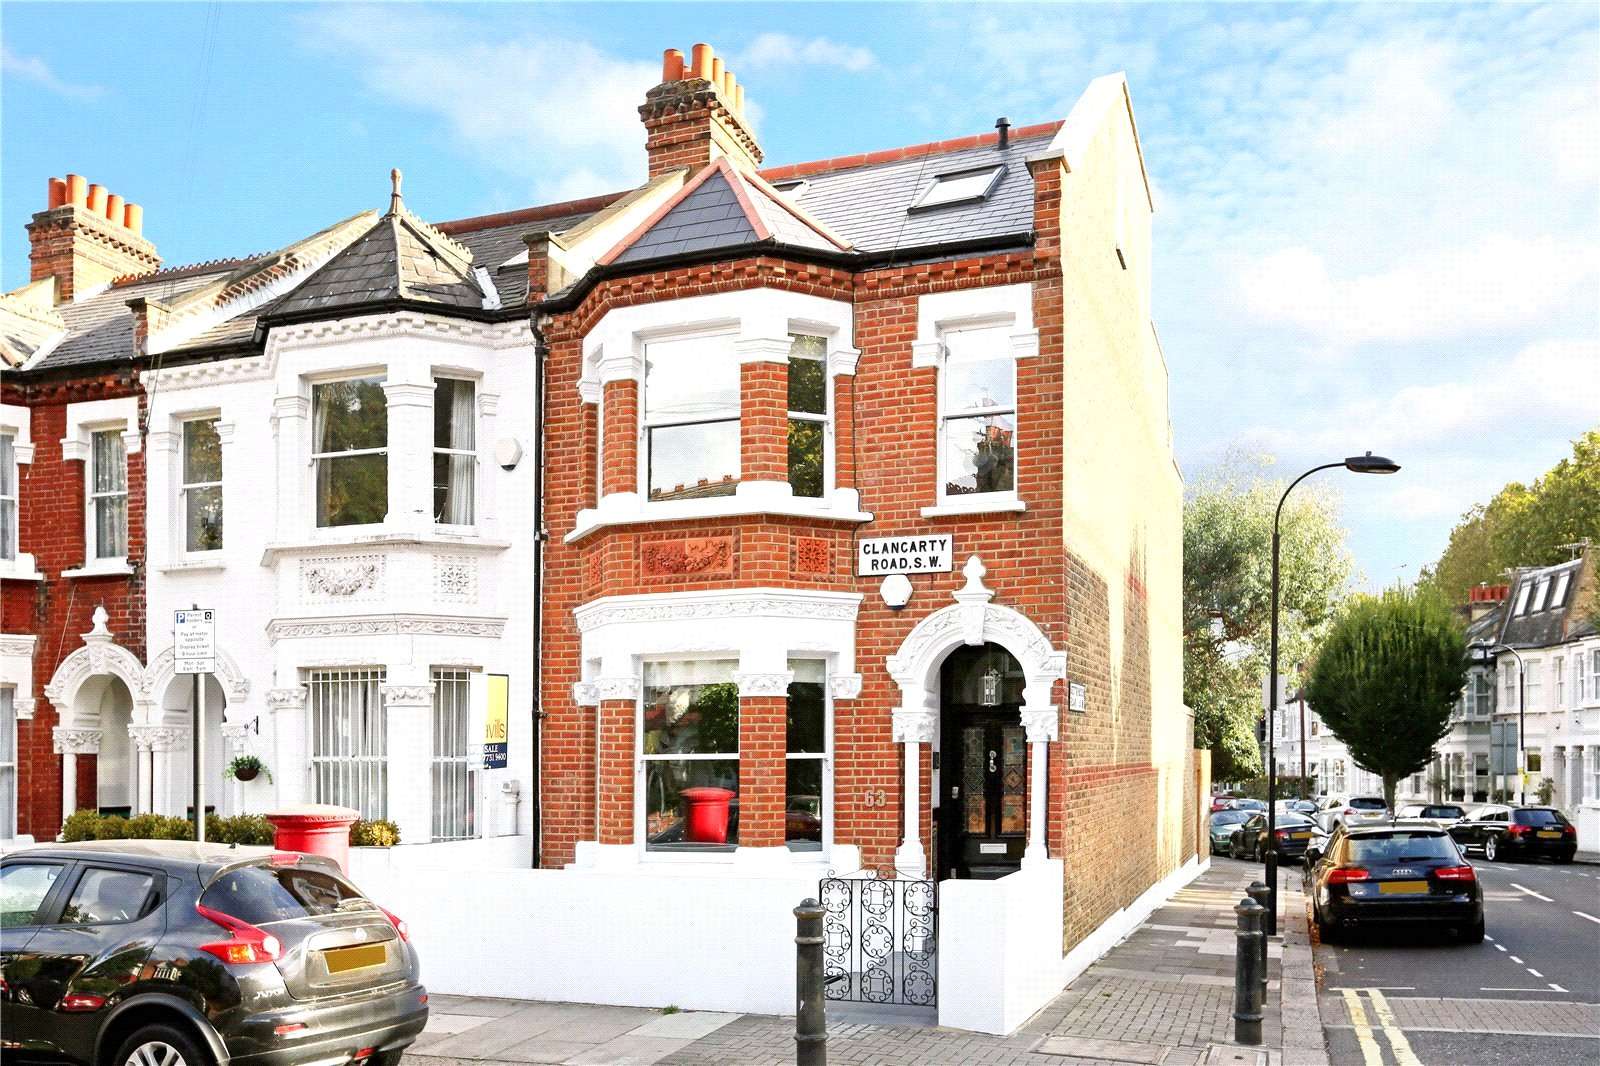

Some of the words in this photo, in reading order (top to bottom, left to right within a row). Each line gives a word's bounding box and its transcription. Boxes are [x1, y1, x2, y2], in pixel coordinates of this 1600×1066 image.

[863, 539, 947, 555] CLANCARTY
[177, 613, 185, 623] P
[484, 744, 499, 753] SALE
[864, 789, 886, 807] 63
